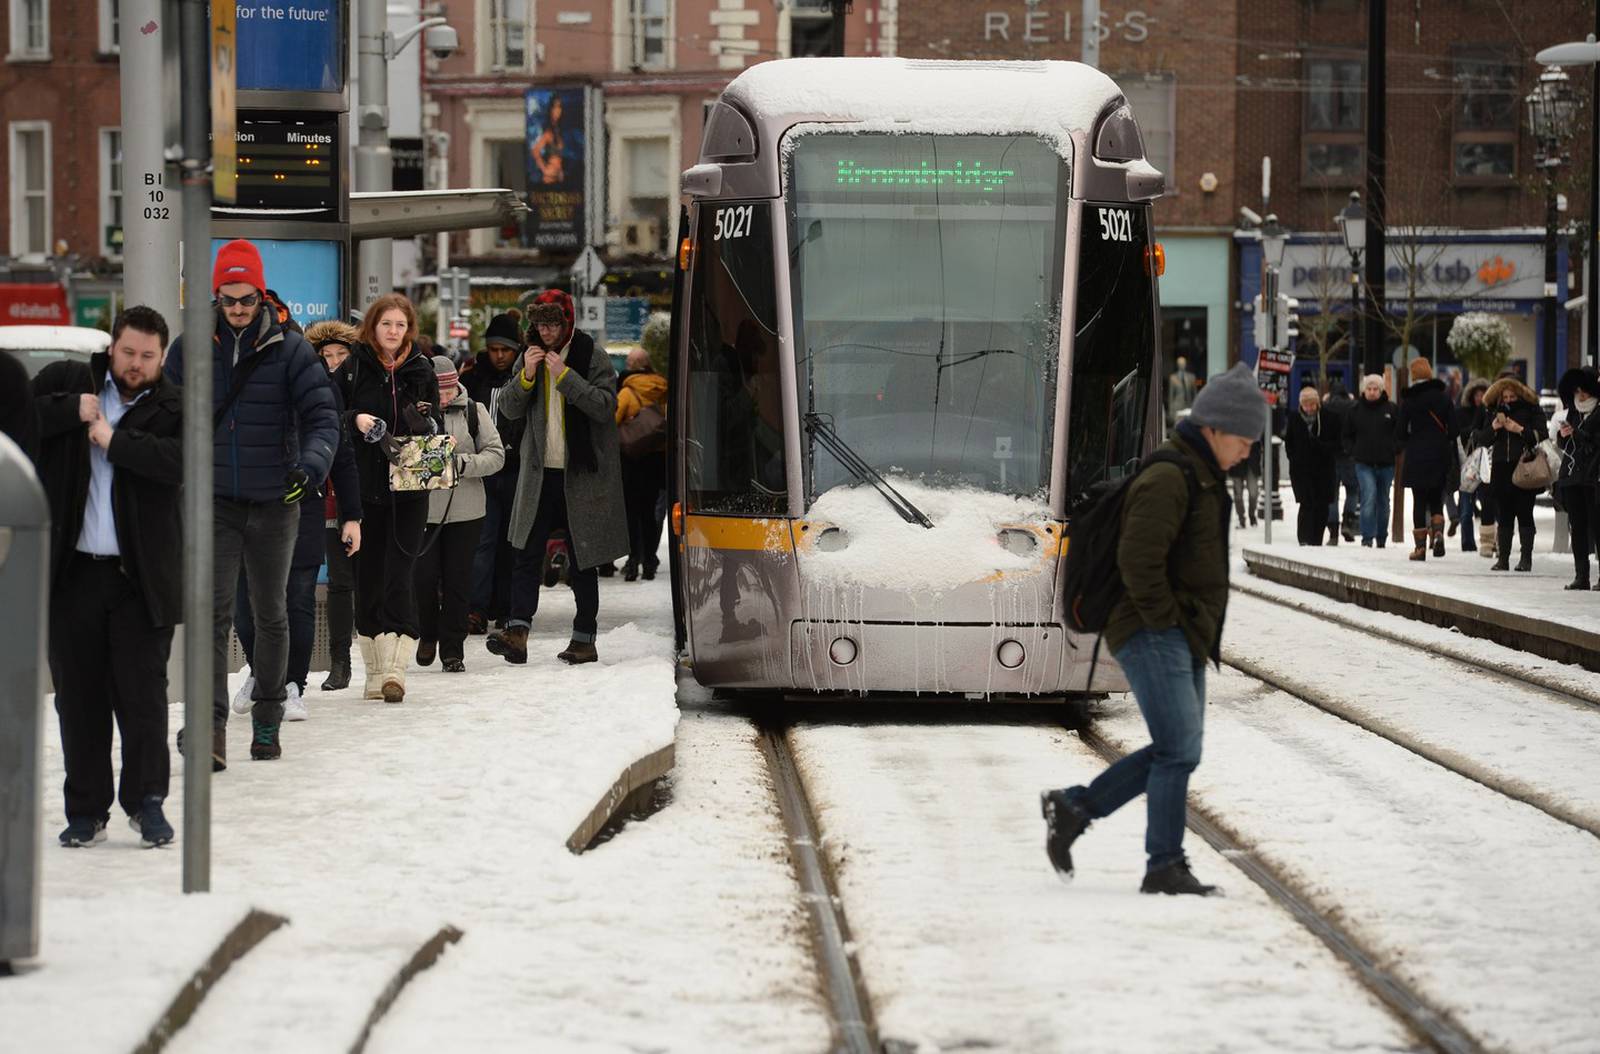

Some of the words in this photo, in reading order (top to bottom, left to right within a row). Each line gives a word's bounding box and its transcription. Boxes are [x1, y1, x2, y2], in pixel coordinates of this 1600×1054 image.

[236, 4, 257, 19] for
[261, 7, 285, 20] the
[287, 132, 332, 144] Minutes
[148, 189, 164, 203] 10
[143, 206, 170, 220] 032
[713, 205, 753, 241] 5021
[1098, 207, 1132, 242] 5021
[1434, 259, 1472, 285] tsb
[287, 300, 303, 316] to
[307, 303, 328, 316] our
